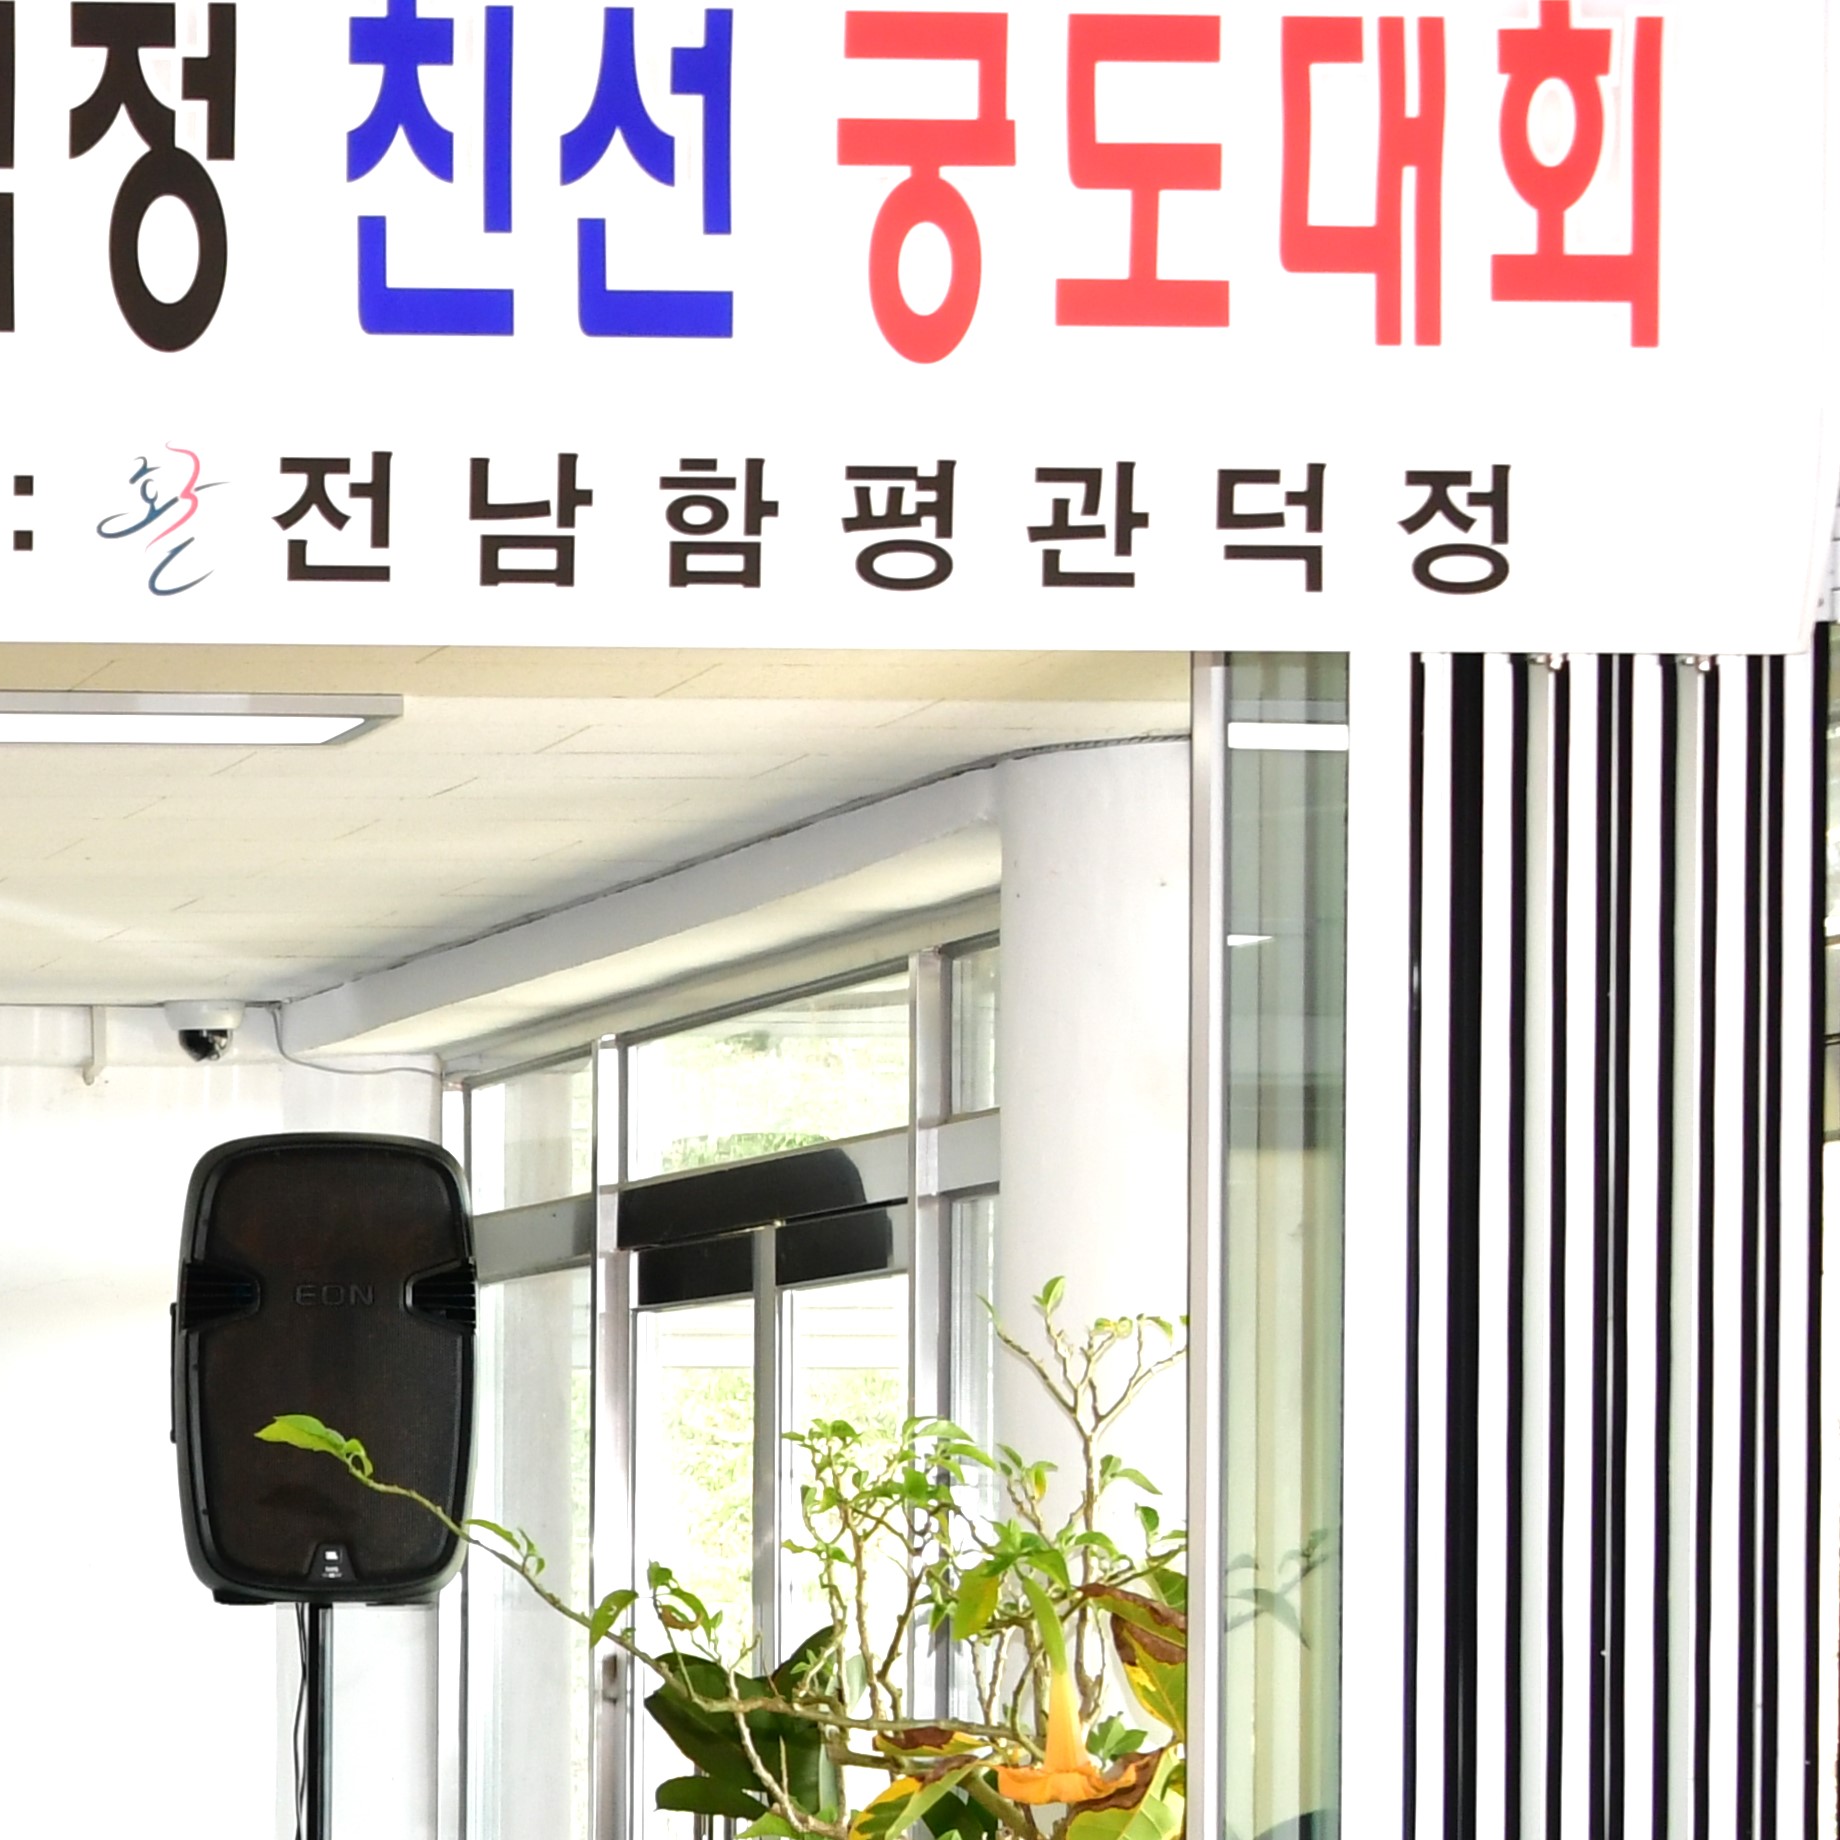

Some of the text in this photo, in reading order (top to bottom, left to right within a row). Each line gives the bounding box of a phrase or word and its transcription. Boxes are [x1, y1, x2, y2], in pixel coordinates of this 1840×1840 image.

[348, 0, 732, 337] 친선
[839, 0, 1662, 362] 궁도대회
[296, 1284, 374, 1306] EON
